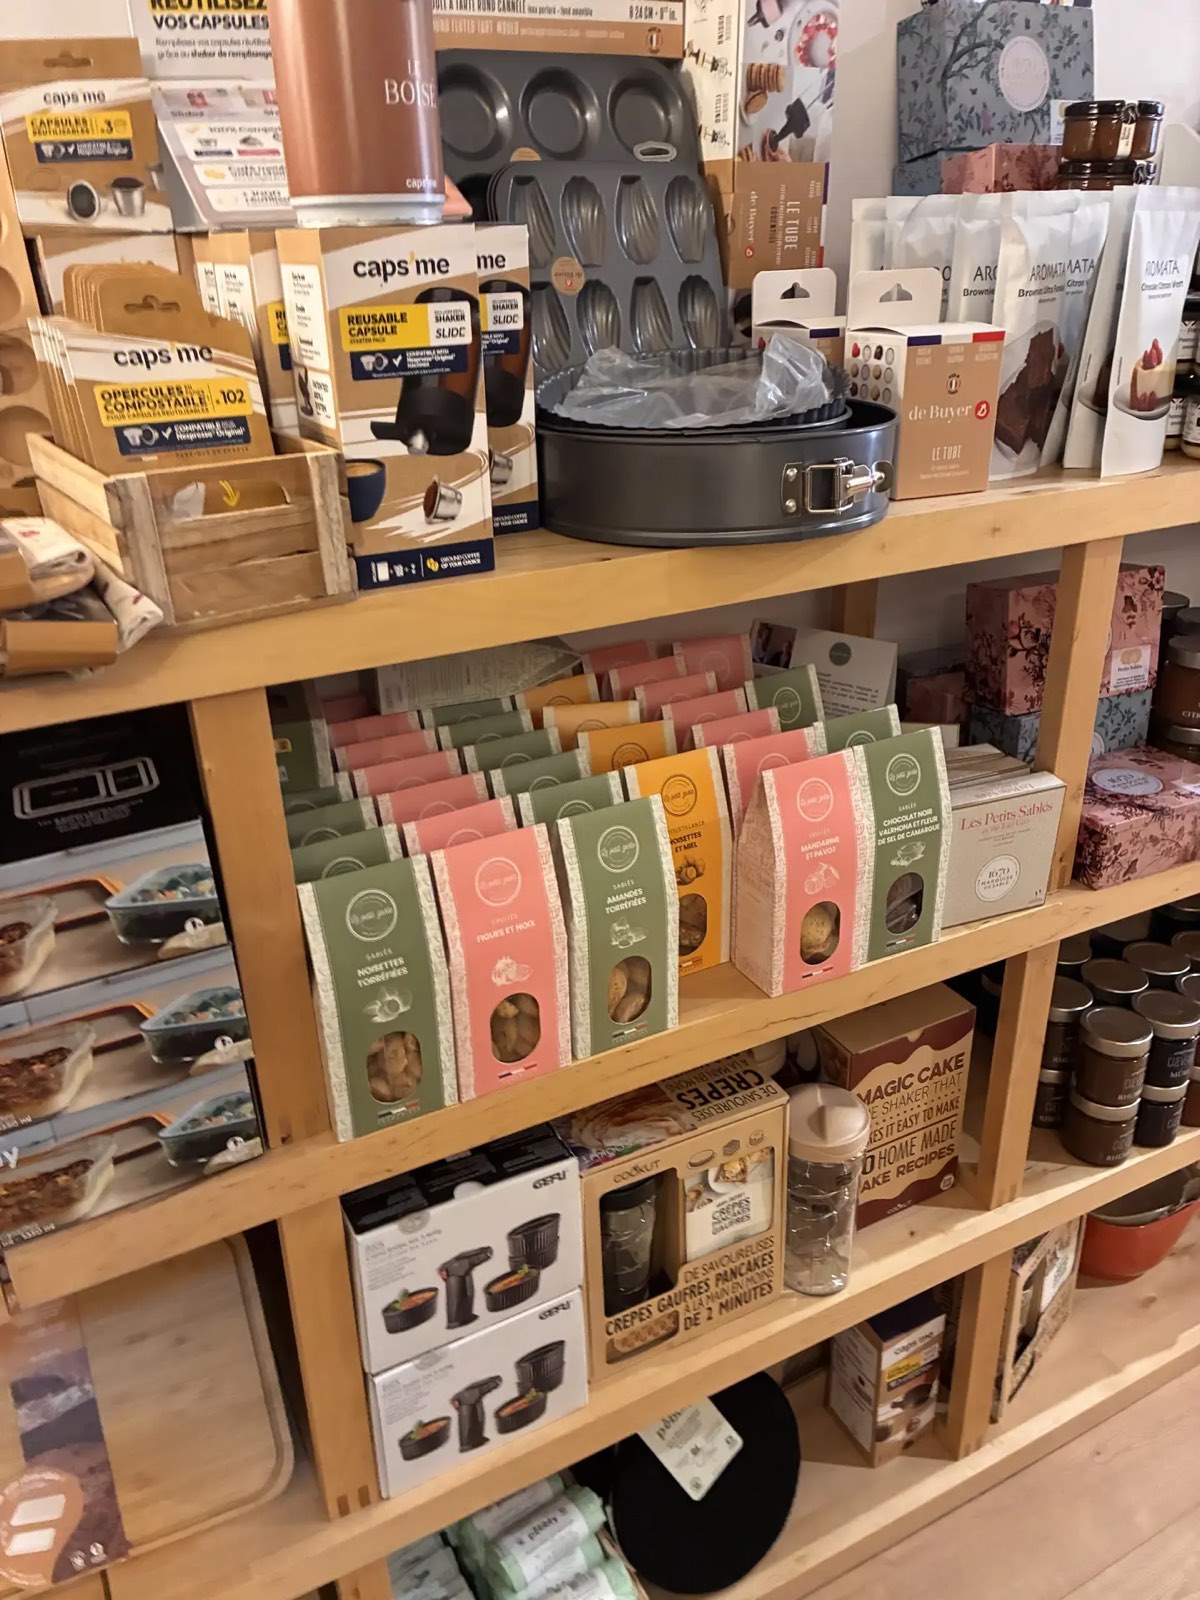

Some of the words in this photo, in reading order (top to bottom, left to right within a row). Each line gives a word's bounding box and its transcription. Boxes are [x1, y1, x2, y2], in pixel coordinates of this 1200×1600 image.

[153, 15, 187, 30] VOS
[189, 15, 269, 30] CAPSULES
[30, 116, 89, 130] CAPSULES
[786, 201, 800, 214] LE
[784, 219, 800, 250] TUBE
[492, 303, 519, 312] SHAKER
[348, 312, 408, 326] REUSABLE
[434, 314, 466, 324] SHAKER
[349, 325, 398, 337] CAPSULE
[101, 385, 184, 402] OPERCULES
[908, 405, 926, 421] de
[930, 405, 972, 424] Buyer
[932, 447, 942, 461] LE
[943, 445, 962, 461] TUBE
[878, 823, 912, 837] VALRHONA
[913, 820, 920, 828] ET
[921, 816, 938, 826] FLEUR
[883, 811, 918, 827] CHOCOLAT
[918, 808, 933, 817] NOIR
[961, 818, 982, 831] Les
[985, 810, 1017, 826] Petits
[801, 835, 840, 853] MANDARINE
[878, 838, 886, 846] DE
[887, 836, 897, 844] SEL
[897, 832, 906, 841] DE
[906, 823, 941, 838] CAMARGUE
[675, 845, 683, 853] ET
[805, 852, 813, 861] ET
[607, 887, 643, 905] AMANDES
[505, 925, 515, 935] ET
[515, 920, 536, 932] NOIX
[357, 956, 405, 977] NOISETTES
[856, 1072, 915, 1107] MAGIC
[917, 1052, 966, 1084] CAKE
[676, 1068, 765, 1111] CREPES
[766, 1084, 778, 1098] DE
[881, 1085, 930, 1116] SHAKER
[933, 1071, 964, 1094] THAT
[692, 1088, 764, 1122] SAVOUREUSES
[868, 1126, 884, 1146] KES
[885, 1124, 897, 1139] IT
[897, 1112, 920, 1133] EASY
[923, 1106, 934, 1123] TO
[935, 1096, 961, 1118] MAKE
[878, 1136, 918, 1170] HOME
[921, 1120, 958, 1150] MADE
[860, 1169, 892, 1193] AKE
[896, 1143, 956, 1178] RECIPES
[684, 1268, 699, 1284] DE
[701, 1235, 775, 1278] SAVOUREUSES
[605, 1304, 653, 1337] CREPES
[657, 1278, 711, 1314] GAUFRES
[715, 1250, 775, 1287] PANCAKES
[683, 1314, 701, 1331] DE
[706, 1306, 714, 1322] 2
[718, 1279, 774, 1316] MINUTES
[683, 1303, 691, 1316] A
[692, 1298, 704, 1312] LA
